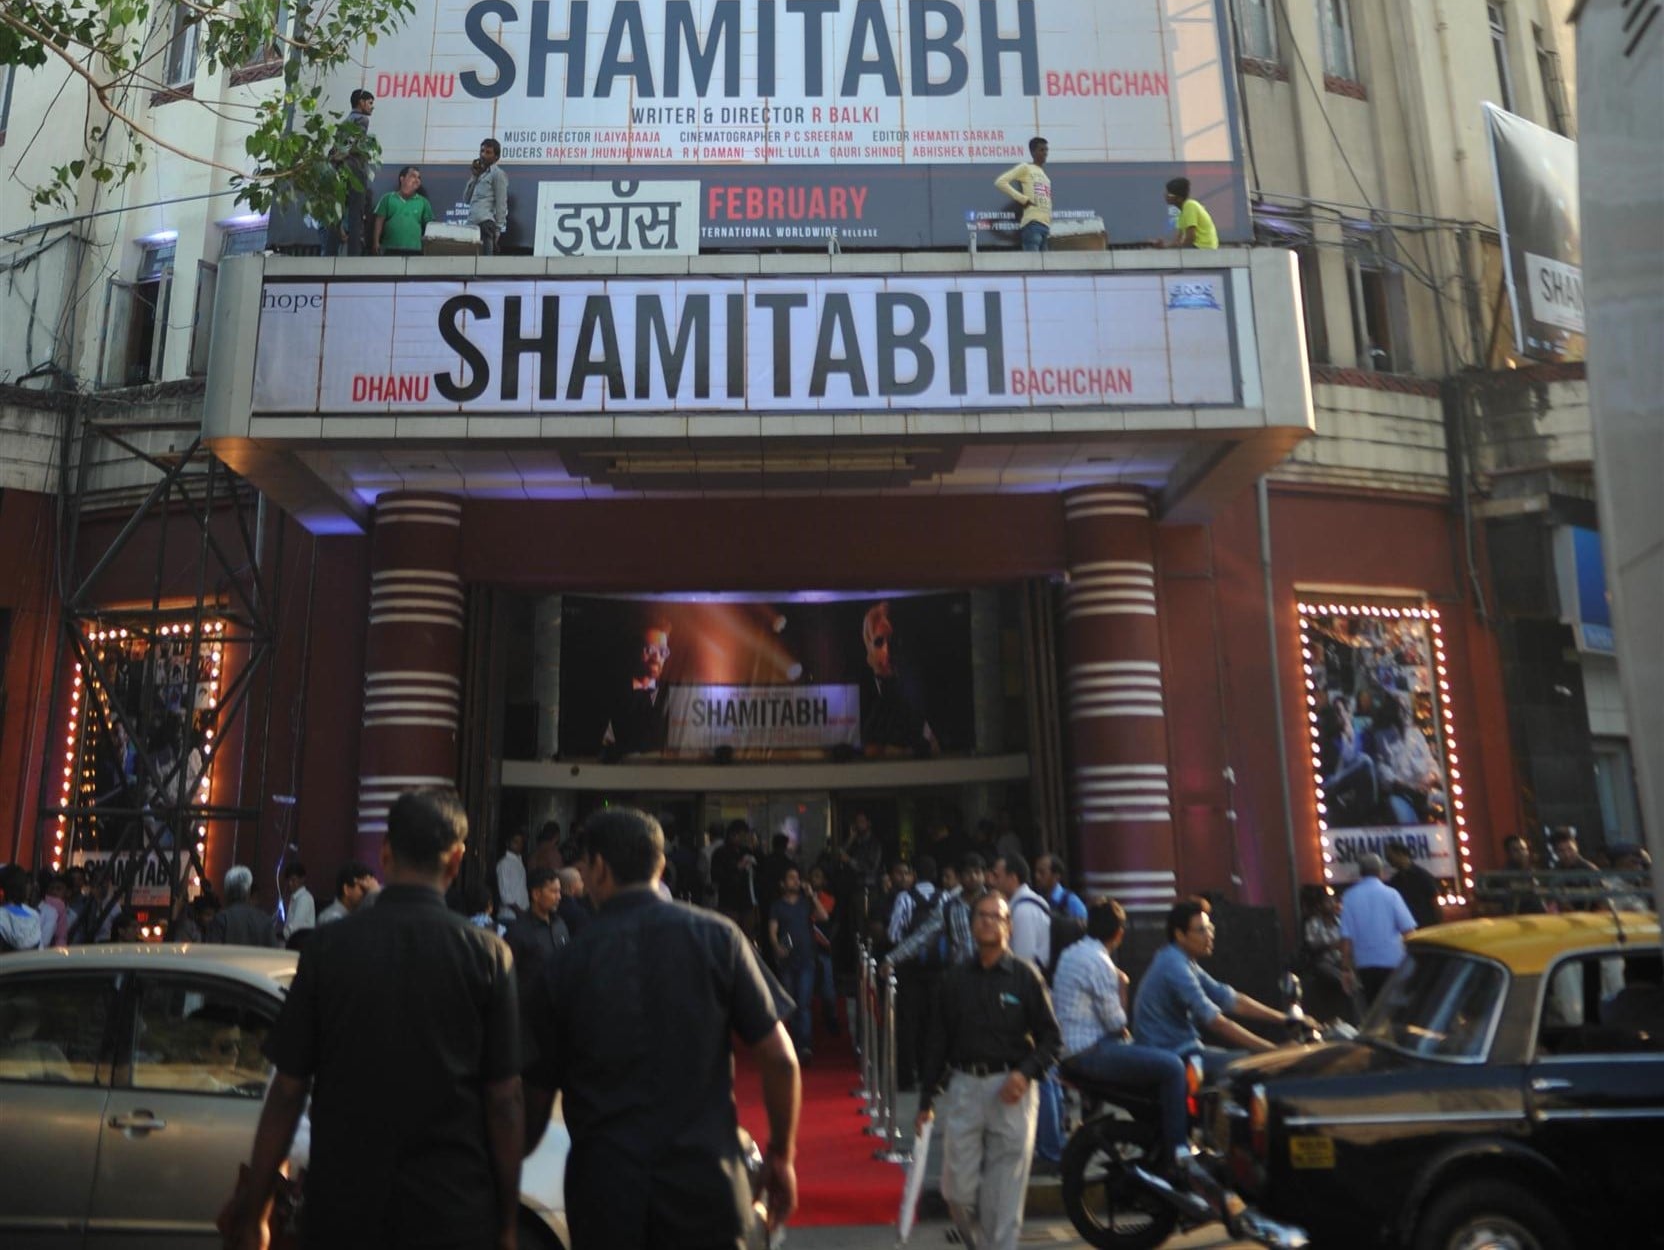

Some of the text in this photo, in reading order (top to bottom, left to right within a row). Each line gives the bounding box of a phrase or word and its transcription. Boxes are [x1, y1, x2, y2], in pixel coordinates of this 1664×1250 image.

[375, 72, 454, 98] DHANU
[1046, 71, 1169, 97] BACHCHAN
[631, 106, 880, 124] WRITER & DIRECTOR R BALKI
[504, 131, 1005, 143] MUSIC DIRECTOR ILAIYARAAJA CINEMATOGRAPHER P C SREERAM EDITOR HEMANTI SARKAR
[501, 146, 1025, 159] DUCERS RAKESH JHUNJHUNWALA R K DAMANI SUNIL LULLA GAURI SHINDE ABHISHEK BACHCHAN
[708, 186, 868, 220] FEBRUARY
[701, 226, 878, 238] TERNATIONAL WORLDWIDE RELEASE
[262, 289, 323, 312] hope
[352, 291, 1133, 403] DHANU SHAMITABH BACHCHAN
[692, 698, 828, 727] SHAMITABH
